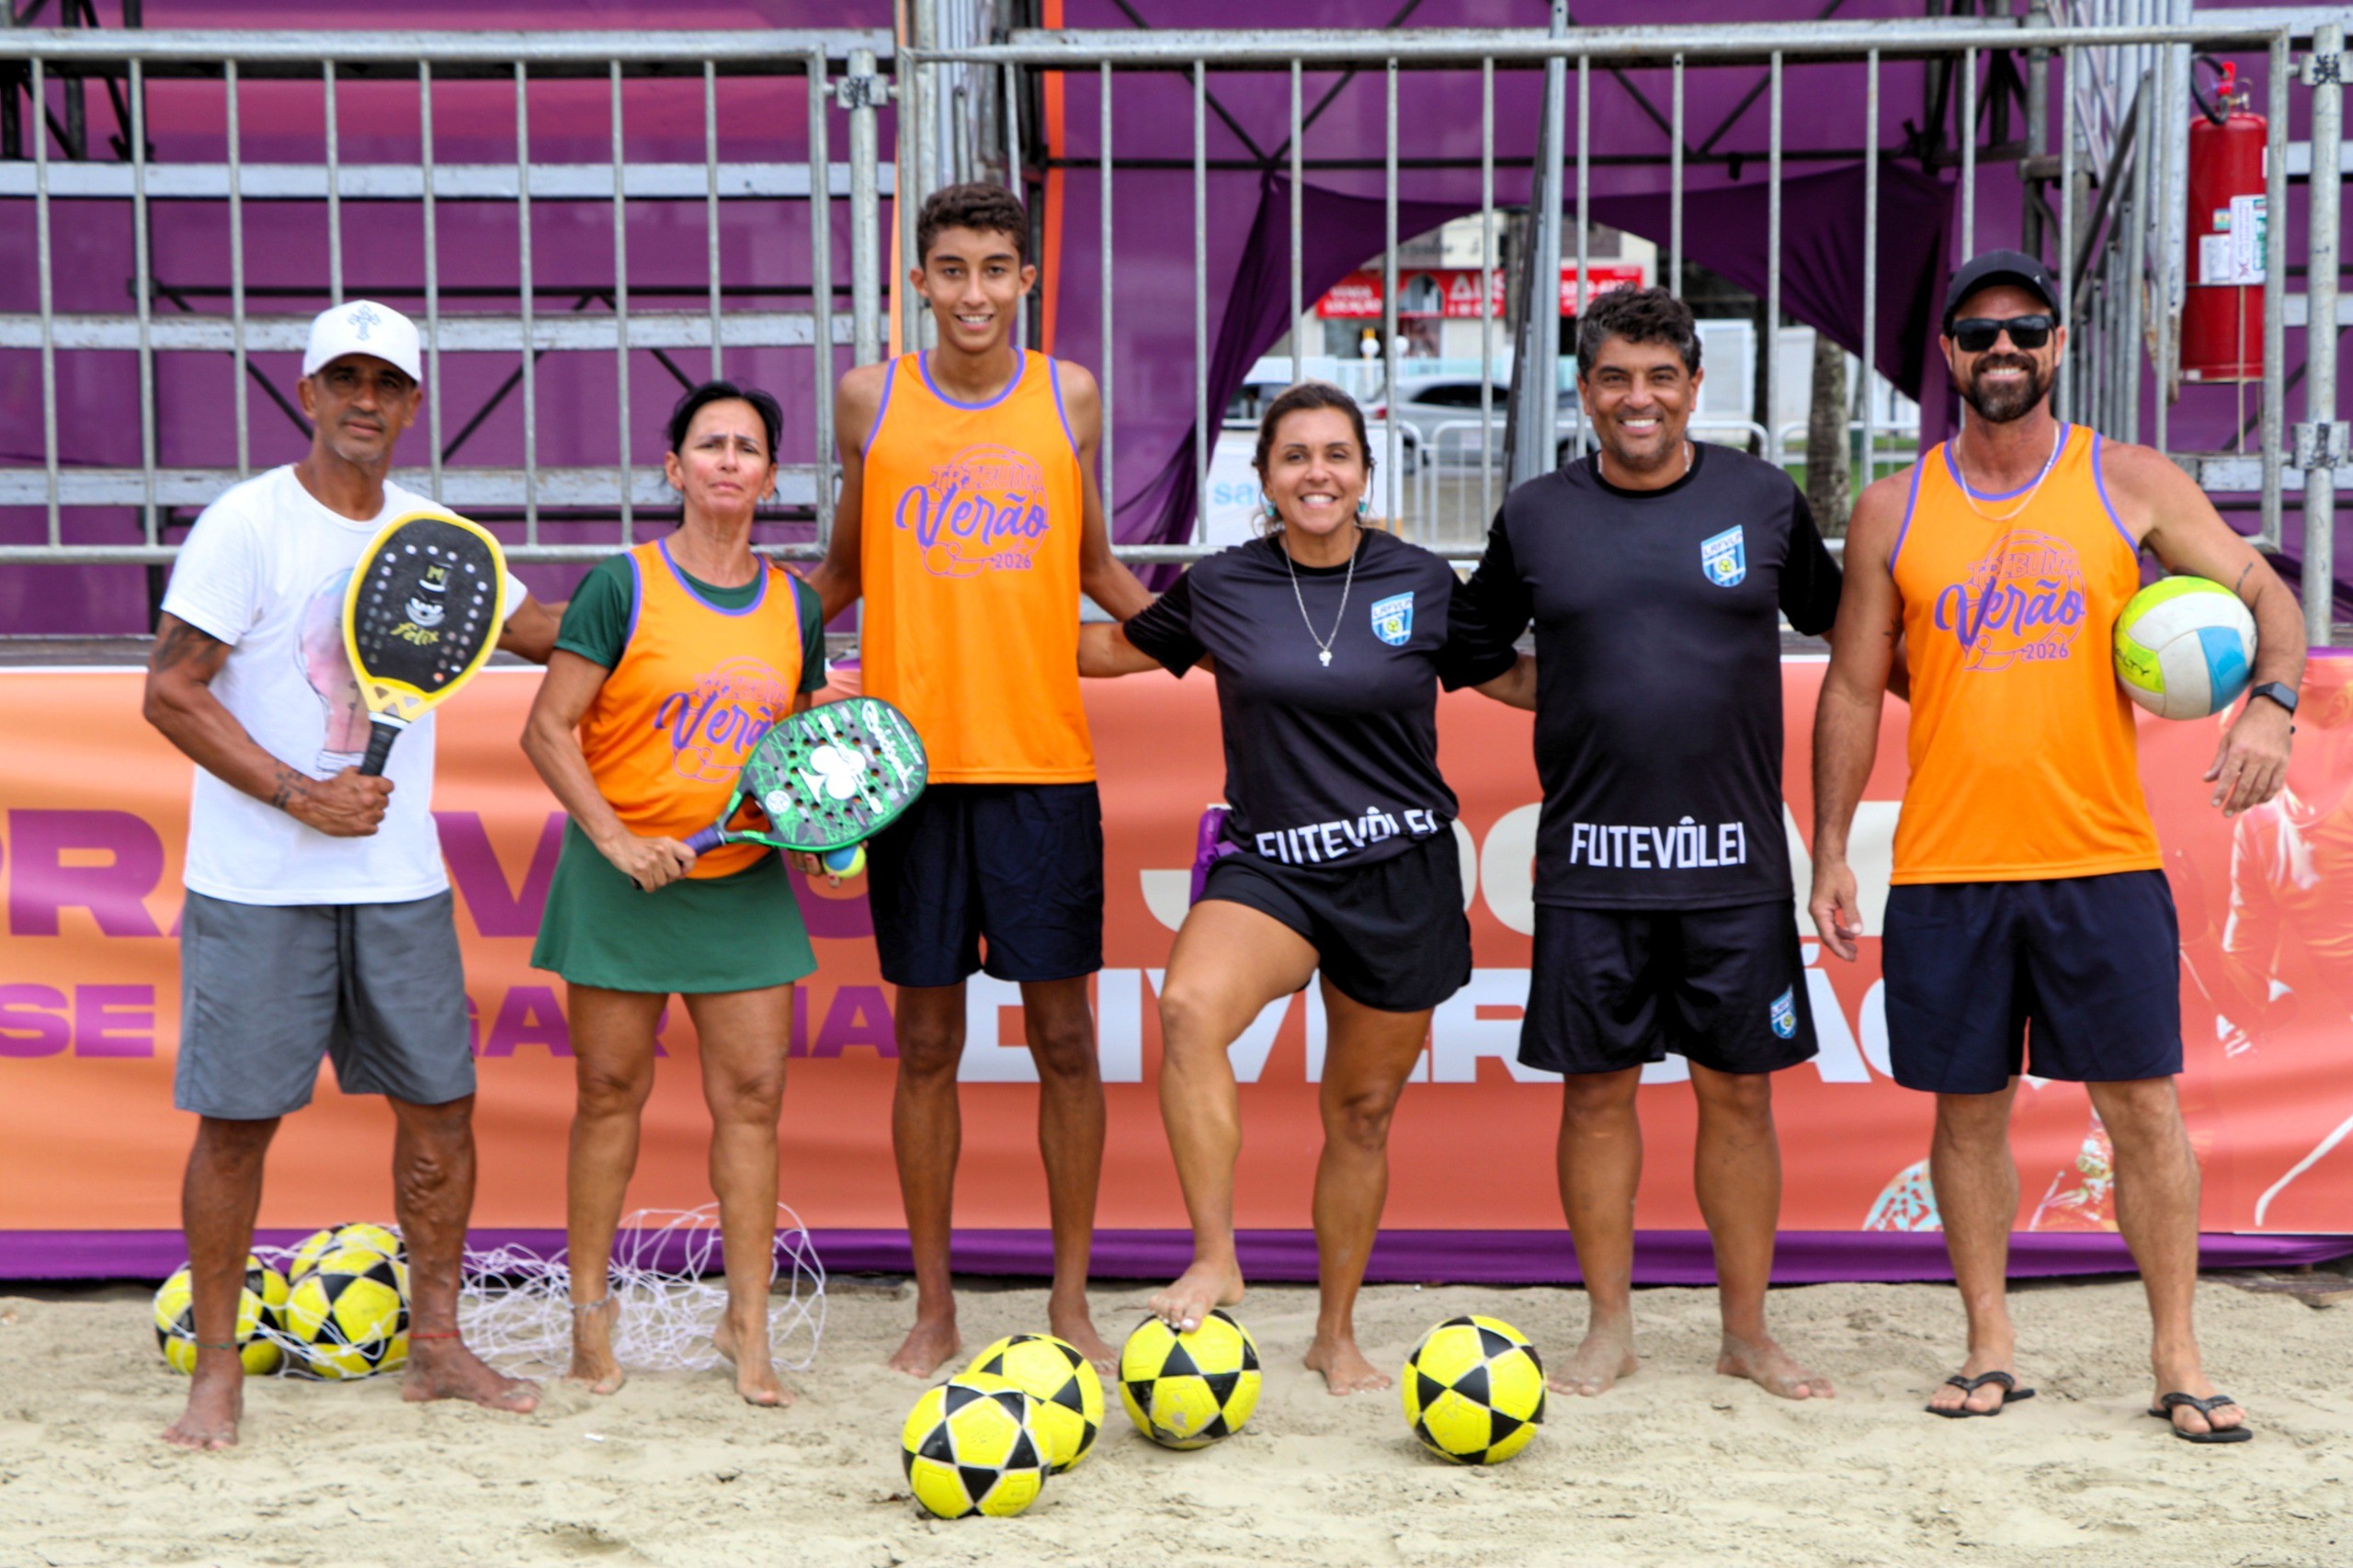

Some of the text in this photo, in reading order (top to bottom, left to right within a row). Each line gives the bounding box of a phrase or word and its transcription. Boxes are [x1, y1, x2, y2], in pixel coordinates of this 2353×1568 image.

[895, 483, 1051, 548] Verão
[992, 551, 1034, 571] 2026
[1934, 576, 2086, 647] Verão
[2023, 642, 2069, 661] 2026
[654, 689, 775, 755] Verã
[1570, 815, 1746, 869] FUTEVÔLEI
